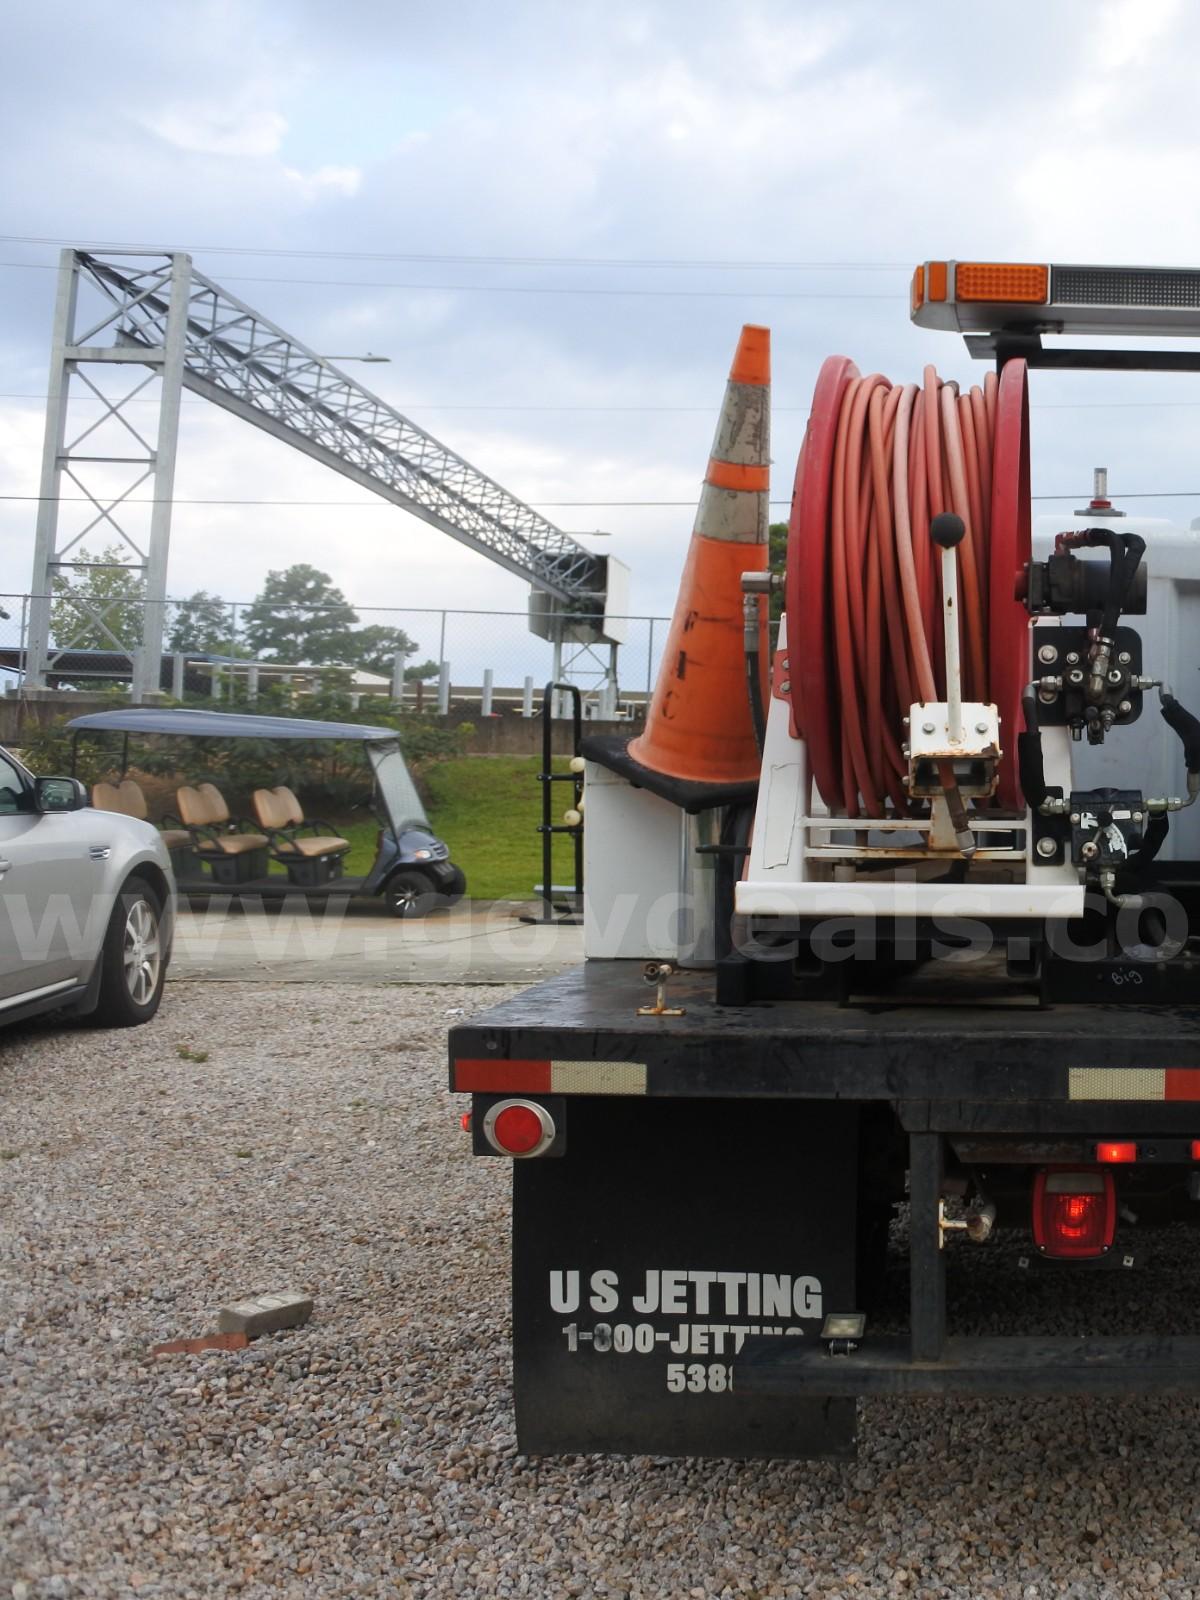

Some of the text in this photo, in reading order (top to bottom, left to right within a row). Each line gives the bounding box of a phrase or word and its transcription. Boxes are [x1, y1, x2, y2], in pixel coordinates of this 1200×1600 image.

[1111, 967, 1143, 985] Big
[550, 1269, 823, 1319] U S JETTING
[562, 1322, 804, 1354] 1-800-JETT
